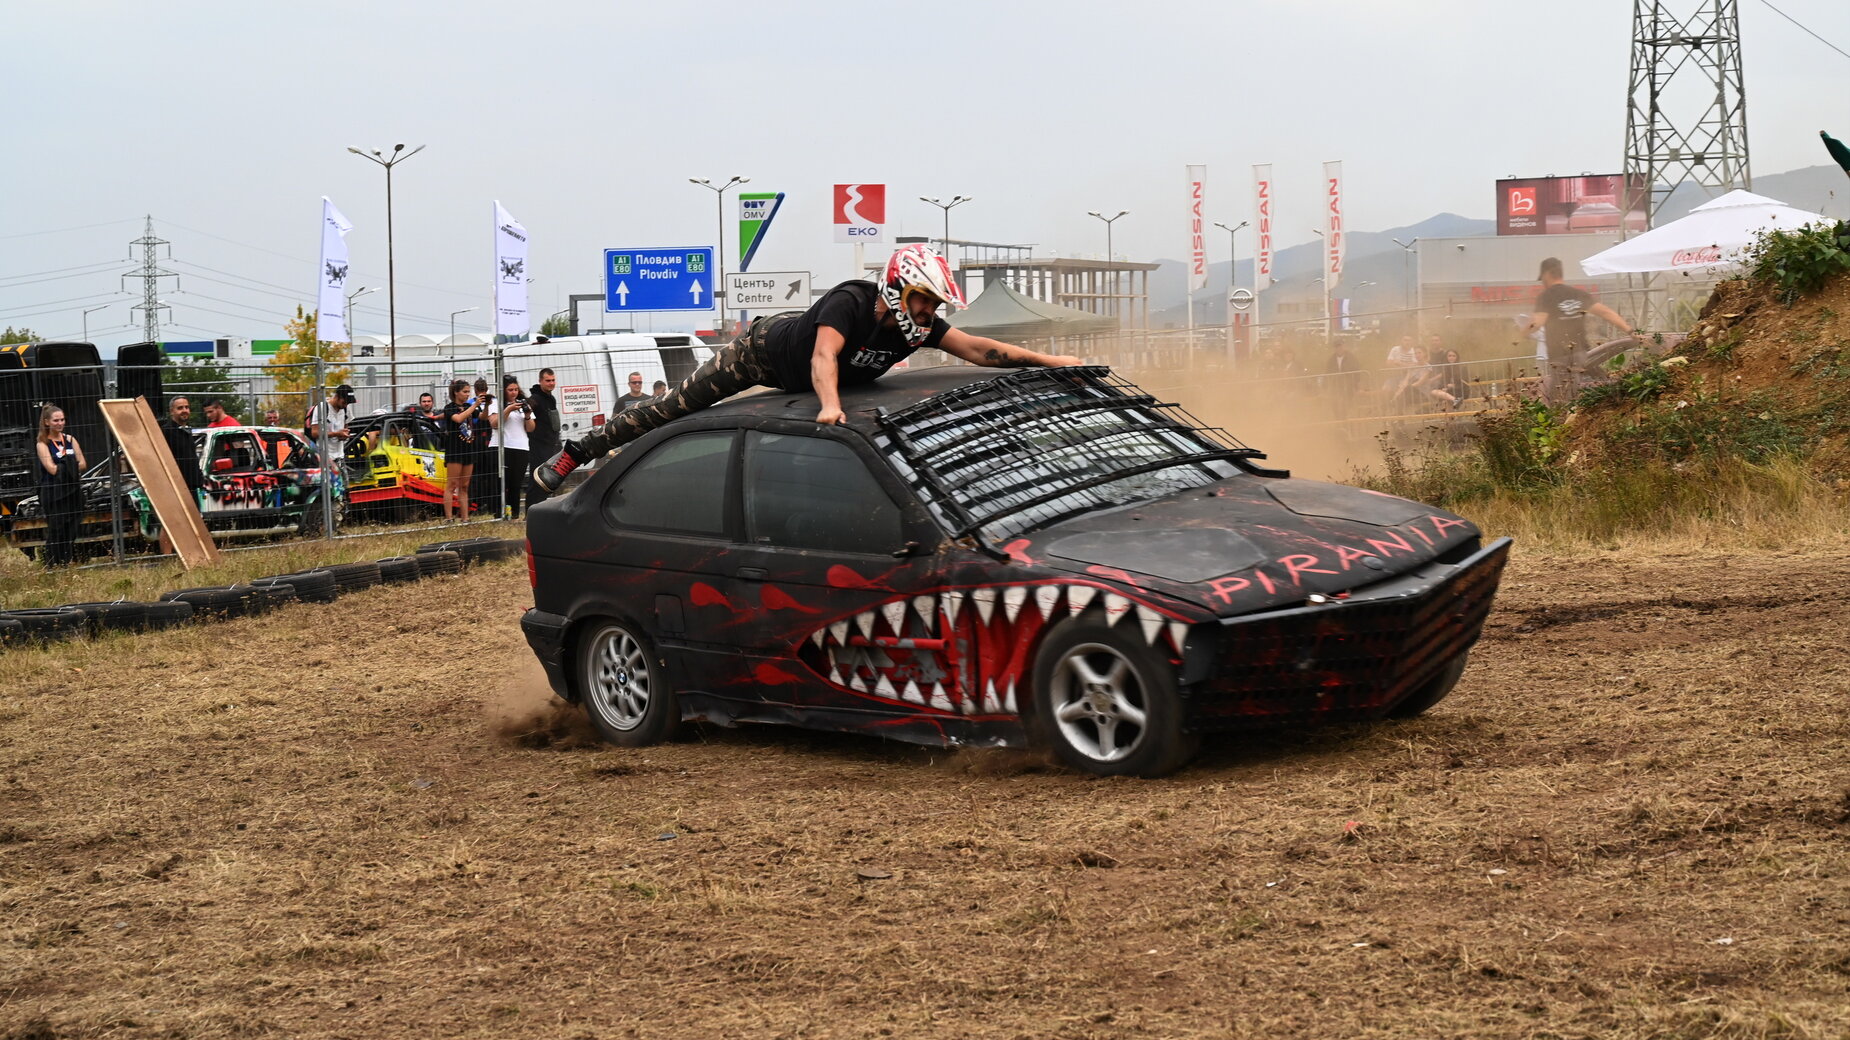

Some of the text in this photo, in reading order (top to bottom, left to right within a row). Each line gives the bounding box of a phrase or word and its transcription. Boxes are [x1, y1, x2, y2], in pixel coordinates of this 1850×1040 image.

[743, 211, 766, 219] OMV
[848, 227, 878, 236] EKO
[1192, 181, 1204, 275] NISSAN
[1258, 181, 1270, 275] NISSAN
[1328, 178, 1341, 273] NISSAN
[635, 254, 683, 266] Пловдив
[690, 255, 701, 263] A1
[614, 265, 630, 273] E80
[688, 263, 704, 272] E80
[639, 268, 679, 280] Plovdiv
[733, 278, 775, 290] Център
[736, 292, 773, 304] Centre
[1206, 515, 1467, 605] PIRANIA
